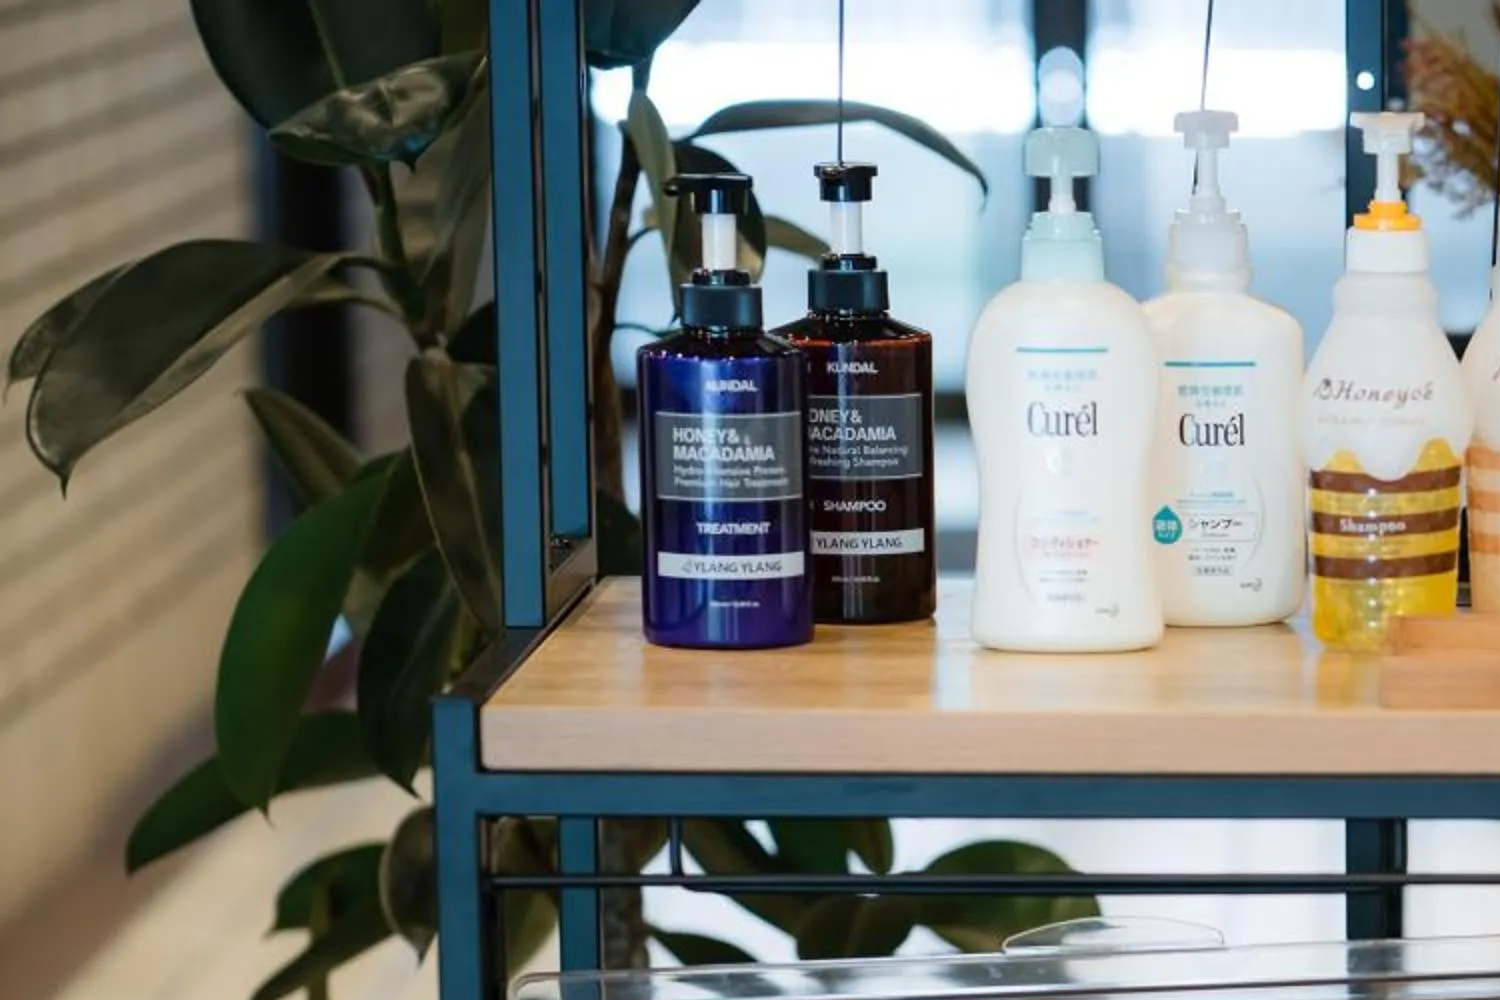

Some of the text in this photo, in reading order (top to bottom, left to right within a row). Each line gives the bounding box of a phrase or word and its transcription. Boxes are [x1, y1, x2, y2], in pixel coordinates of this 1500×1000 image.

[1027, 401, 1098, 437] Curél
[1179, 413, 1245, 446] Curél
[673, 445, 775, 461] MACADAMIA
[823, 500, 886, 512] SHAMPOO
[696, 522, 771, 534] TREATMENT
[816, 536, 903, 549] YLANG YLANG
[693, 560, 782, 573] YLANG YLANG
